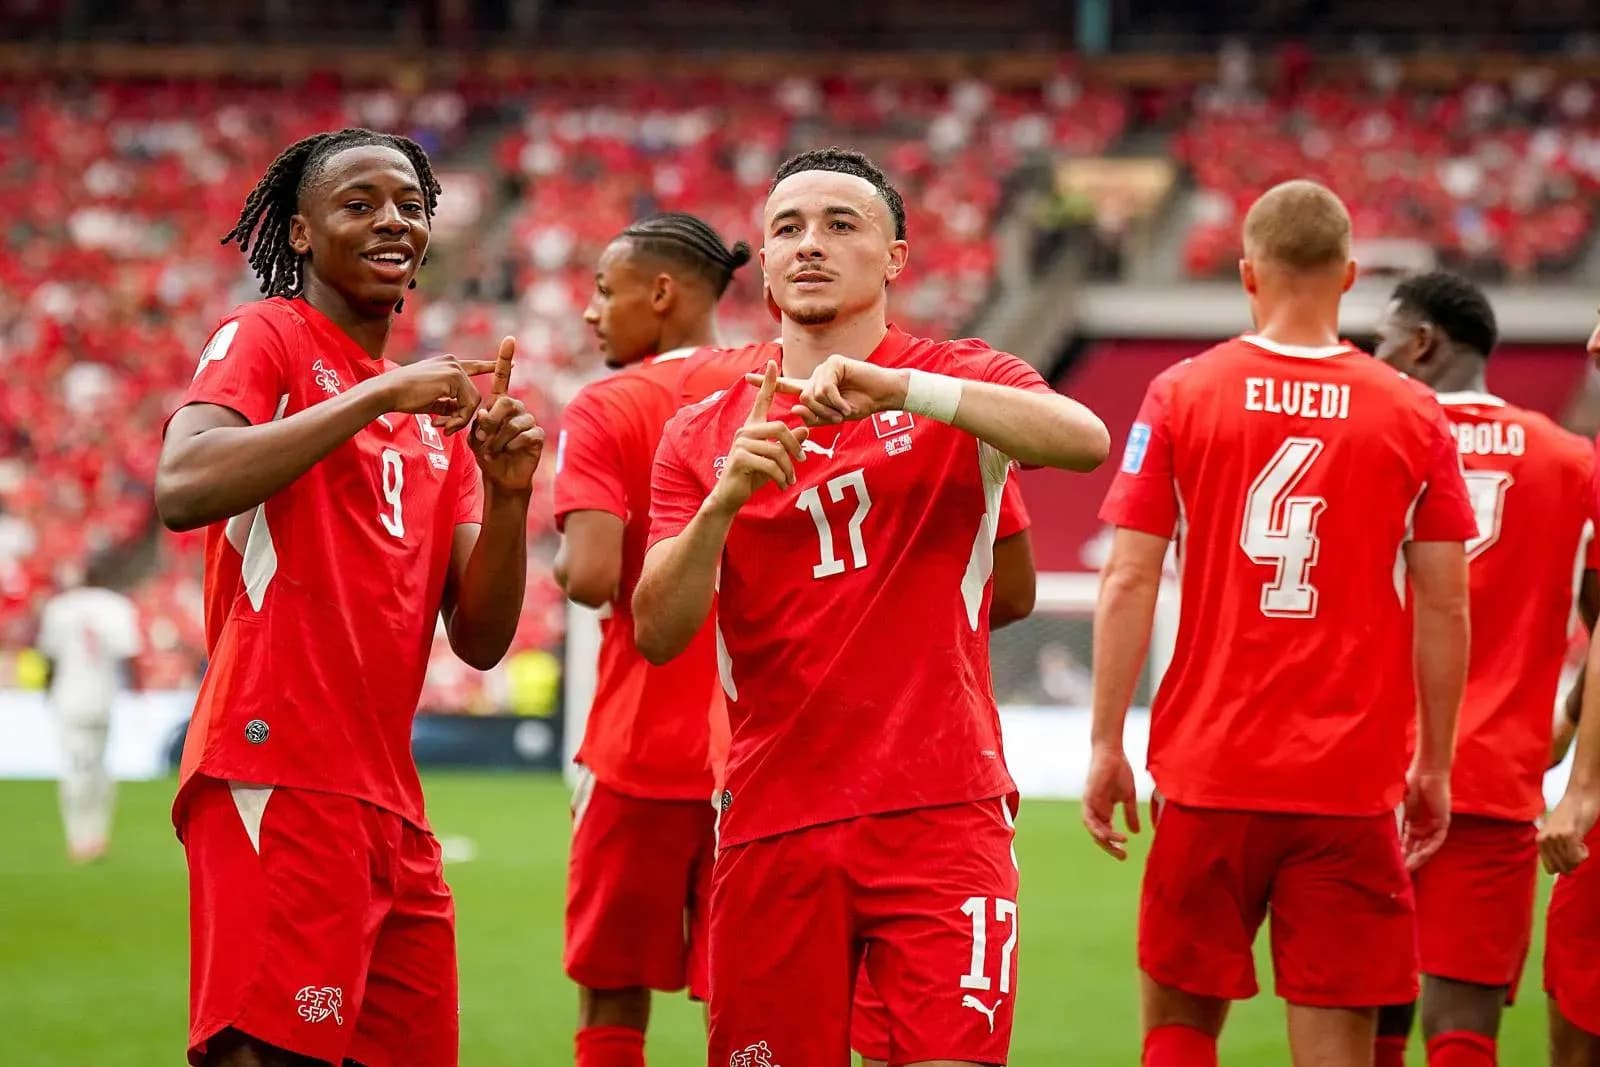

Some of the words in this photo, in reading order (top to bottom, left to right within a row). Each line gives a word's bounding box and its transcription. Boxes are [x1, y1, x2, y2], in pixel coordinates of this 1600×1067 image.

[1244, 377, 1351, 420] ELVEDI
[1450, 420, 1526, 456] BOLO
[379, 448, 405, 539] 9
[795, 468, 872, 579] 17
[1239, 436, 1328, 619] 4
[959, 896, 1018, 994] 17
